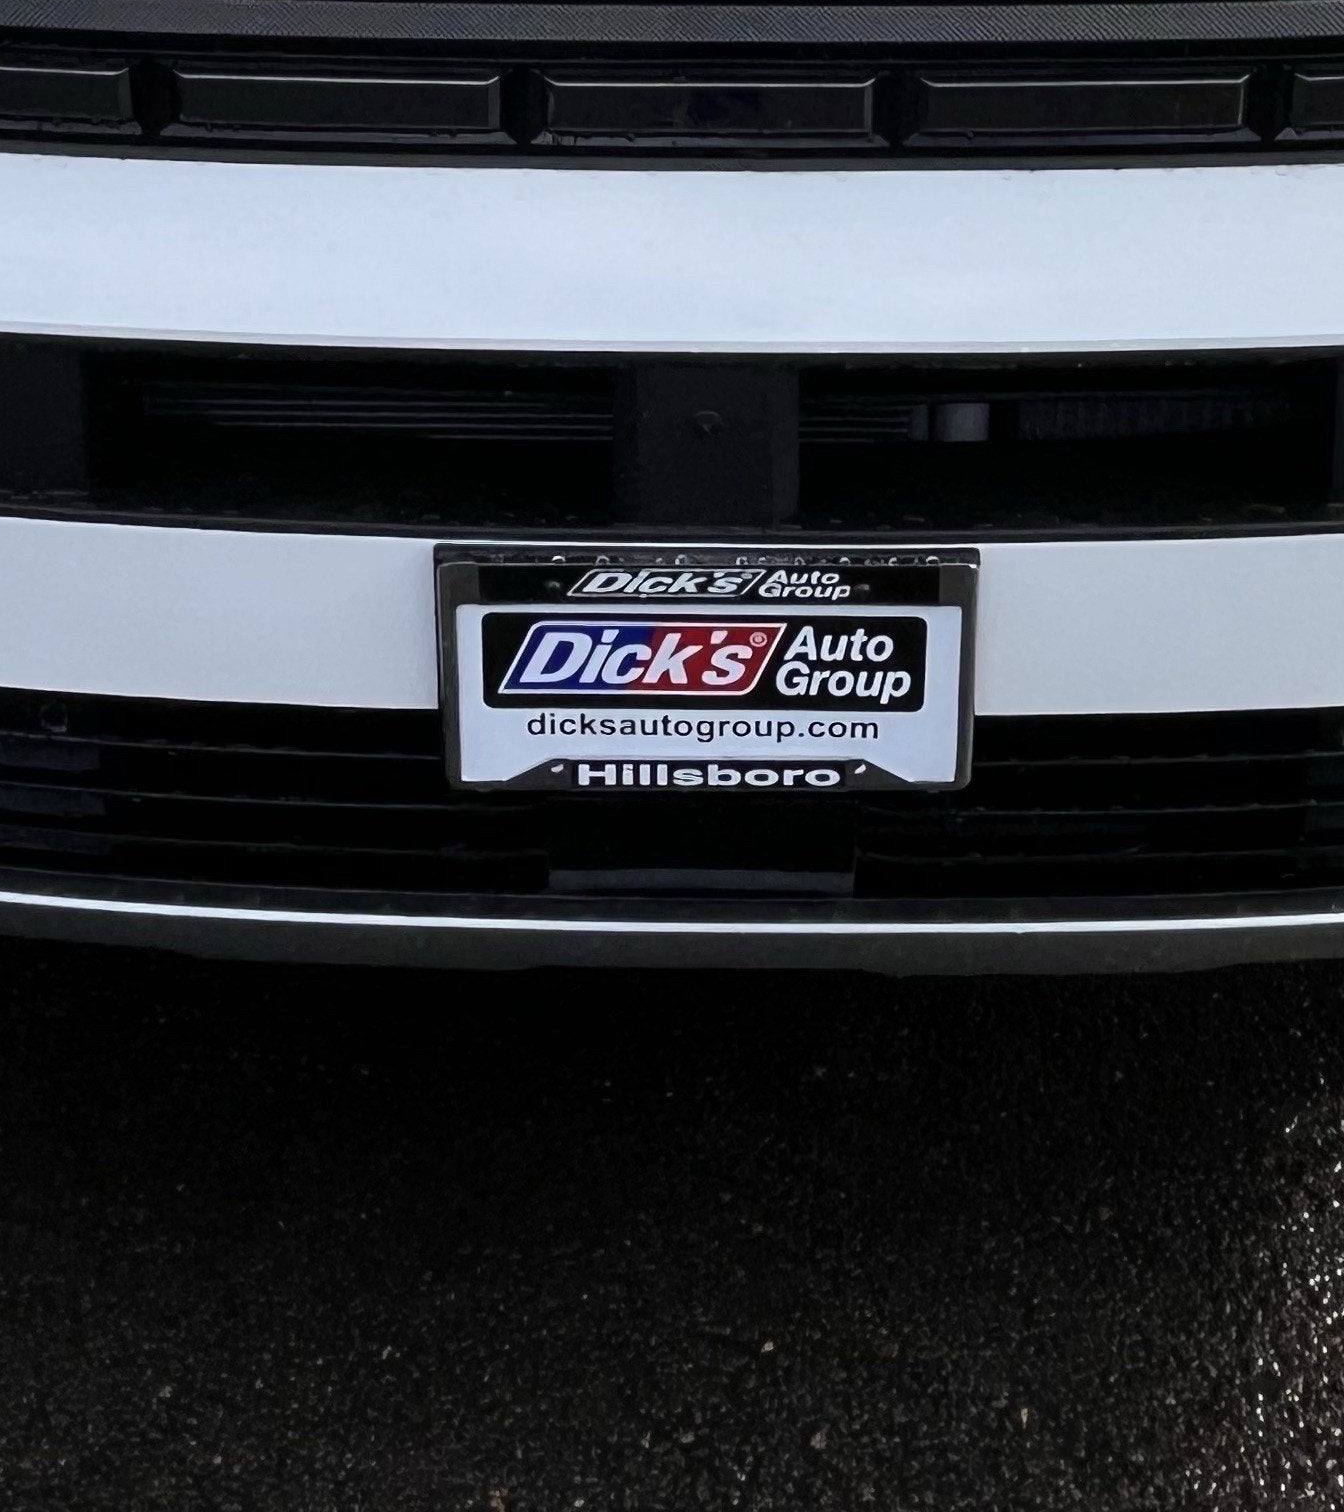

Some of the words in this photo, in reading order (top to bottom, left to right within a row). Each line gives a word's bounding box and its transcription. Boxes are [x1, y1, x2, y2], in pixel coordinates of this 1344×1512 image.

[582, 569, 743, 594] Dick's
[768, 570, 840, 584] Auto
[758, 584, 851, 600] Group
[518, 629, 754, 687] Dick's
[783, 625, 895, 663] Auto
[775, 661, 913, 705] Group
[526, 712, 879, 743] dicksautogroup.com
[577, 763, 842, 787] Hillsboro
